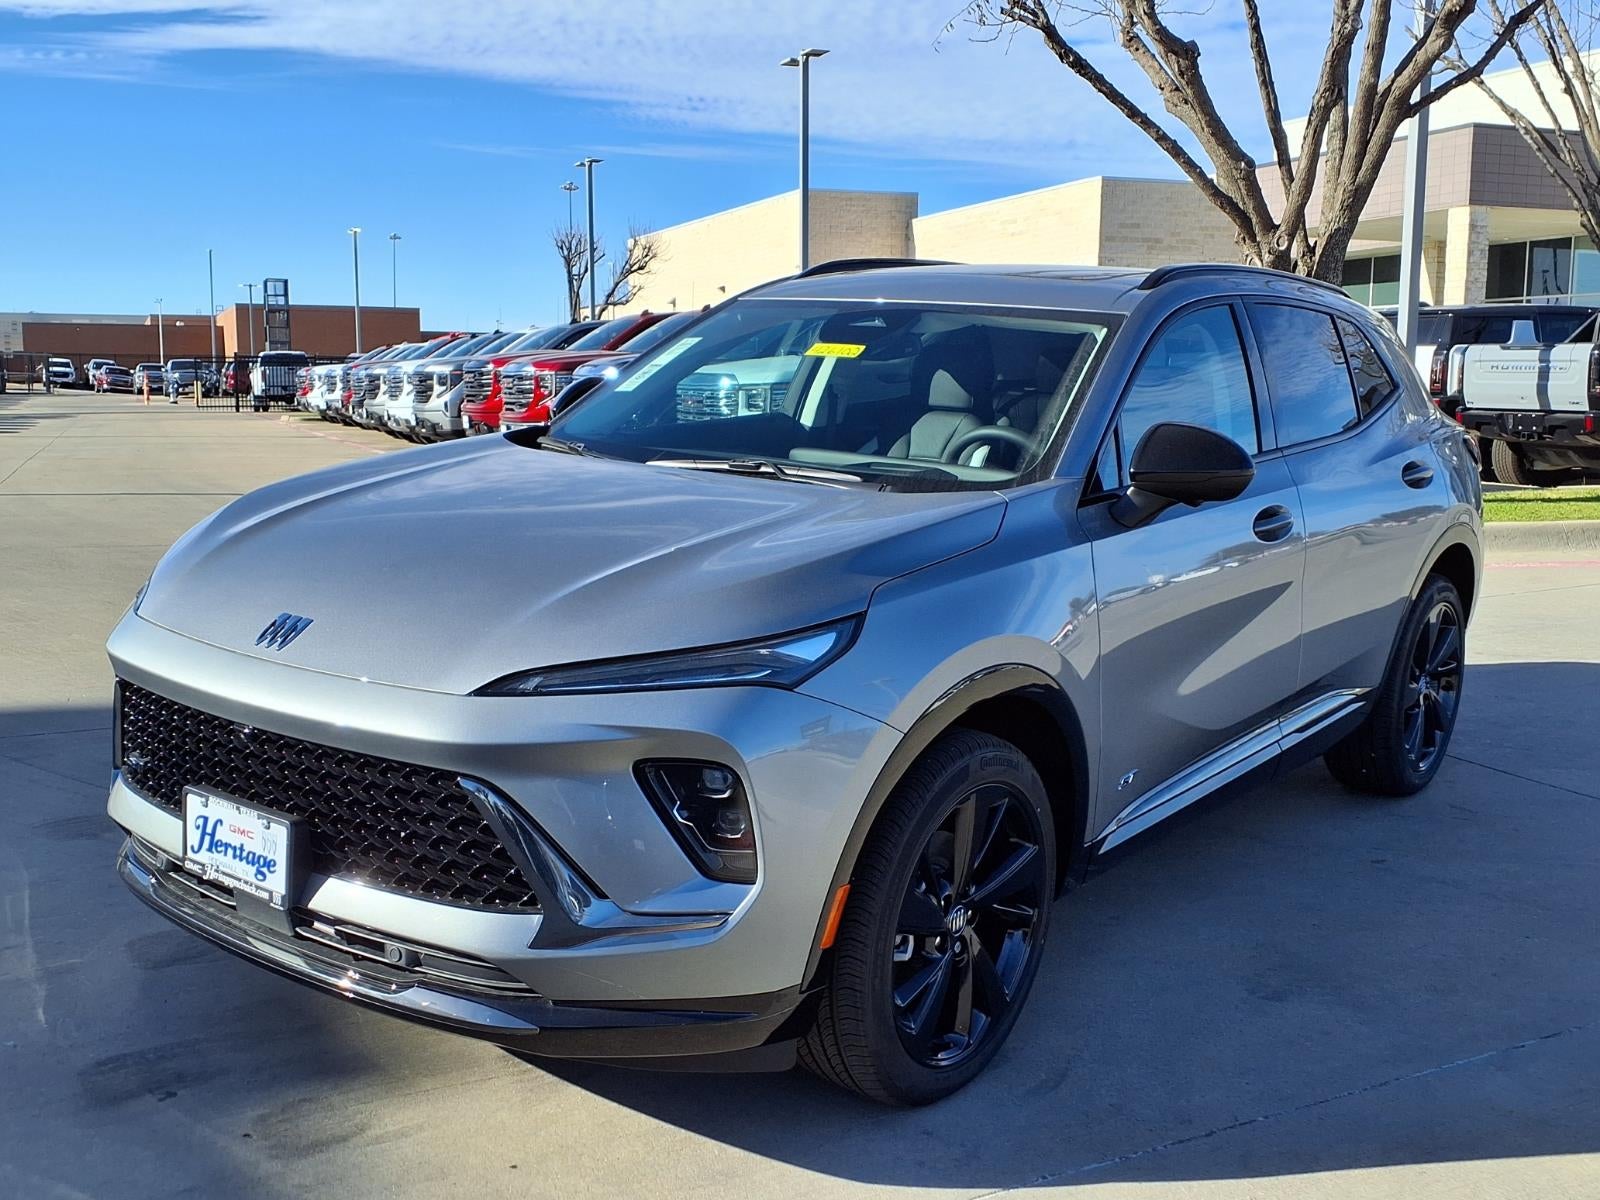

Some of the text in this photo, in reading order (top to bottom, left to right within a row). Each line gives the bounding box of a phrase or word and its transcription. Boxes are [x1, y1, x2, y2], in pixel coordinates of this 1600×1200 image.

[229, 824, 255, 840] GMC
[190, 815, 277, 882] Heritage
[184, 860, 203, 874] GMC
